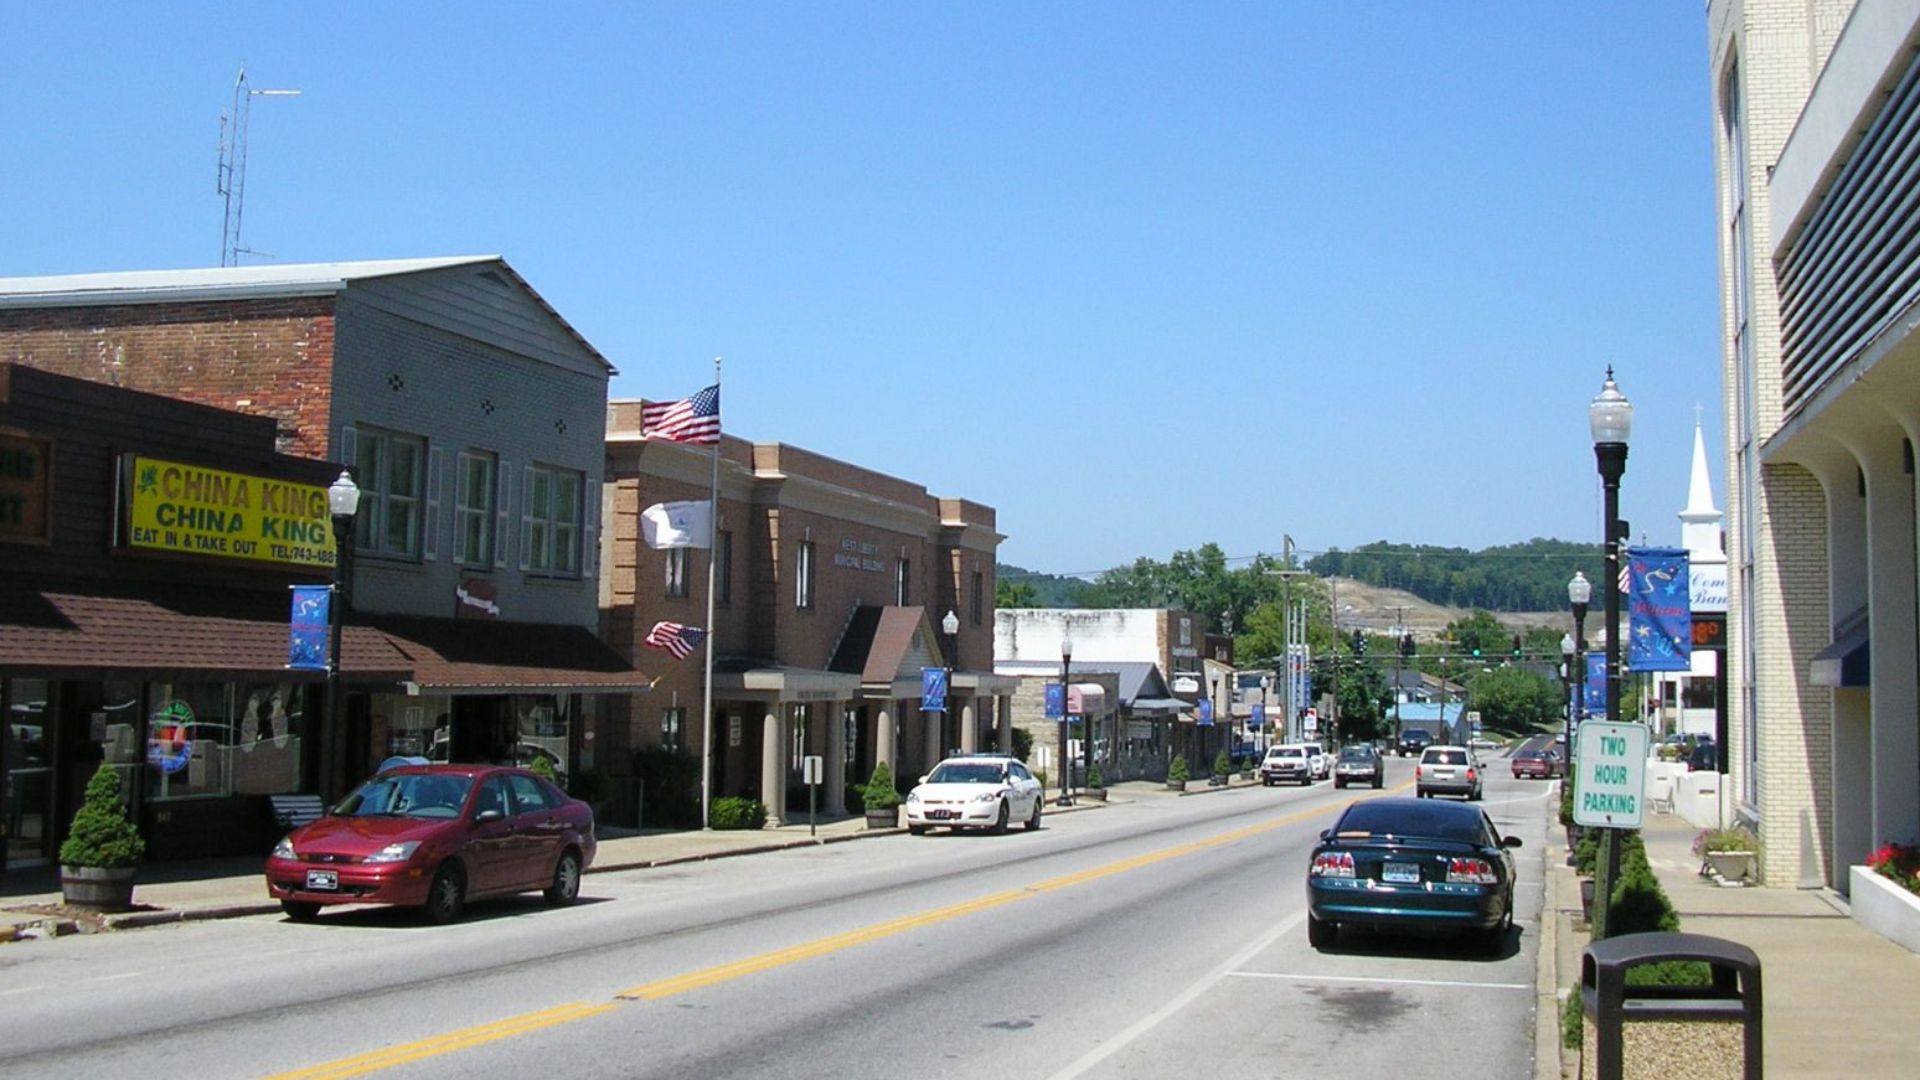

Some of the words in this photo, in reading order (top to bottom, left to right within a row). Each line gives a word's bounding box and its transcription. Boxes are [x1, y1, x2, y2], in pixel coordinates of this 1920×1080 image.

[162, 467, 250, 509] CHINA
[261, 482, 325, 520] KING
[156, 503, 243, 534] CHINA
[262, 516, 326, 545] KING
[134, 527, 159, 542] EAT
[165, 531, 177, 546] IN
[184, 533, 193, 546] &
[195, 535, 227, 552] TAKE
[234, 539, 258, 555] OUT
[1600, 736, 1626, 757] TWO
[1594, 764, 1628, 785] HOUR
[1583, 792, 1636, 814] PARKING
